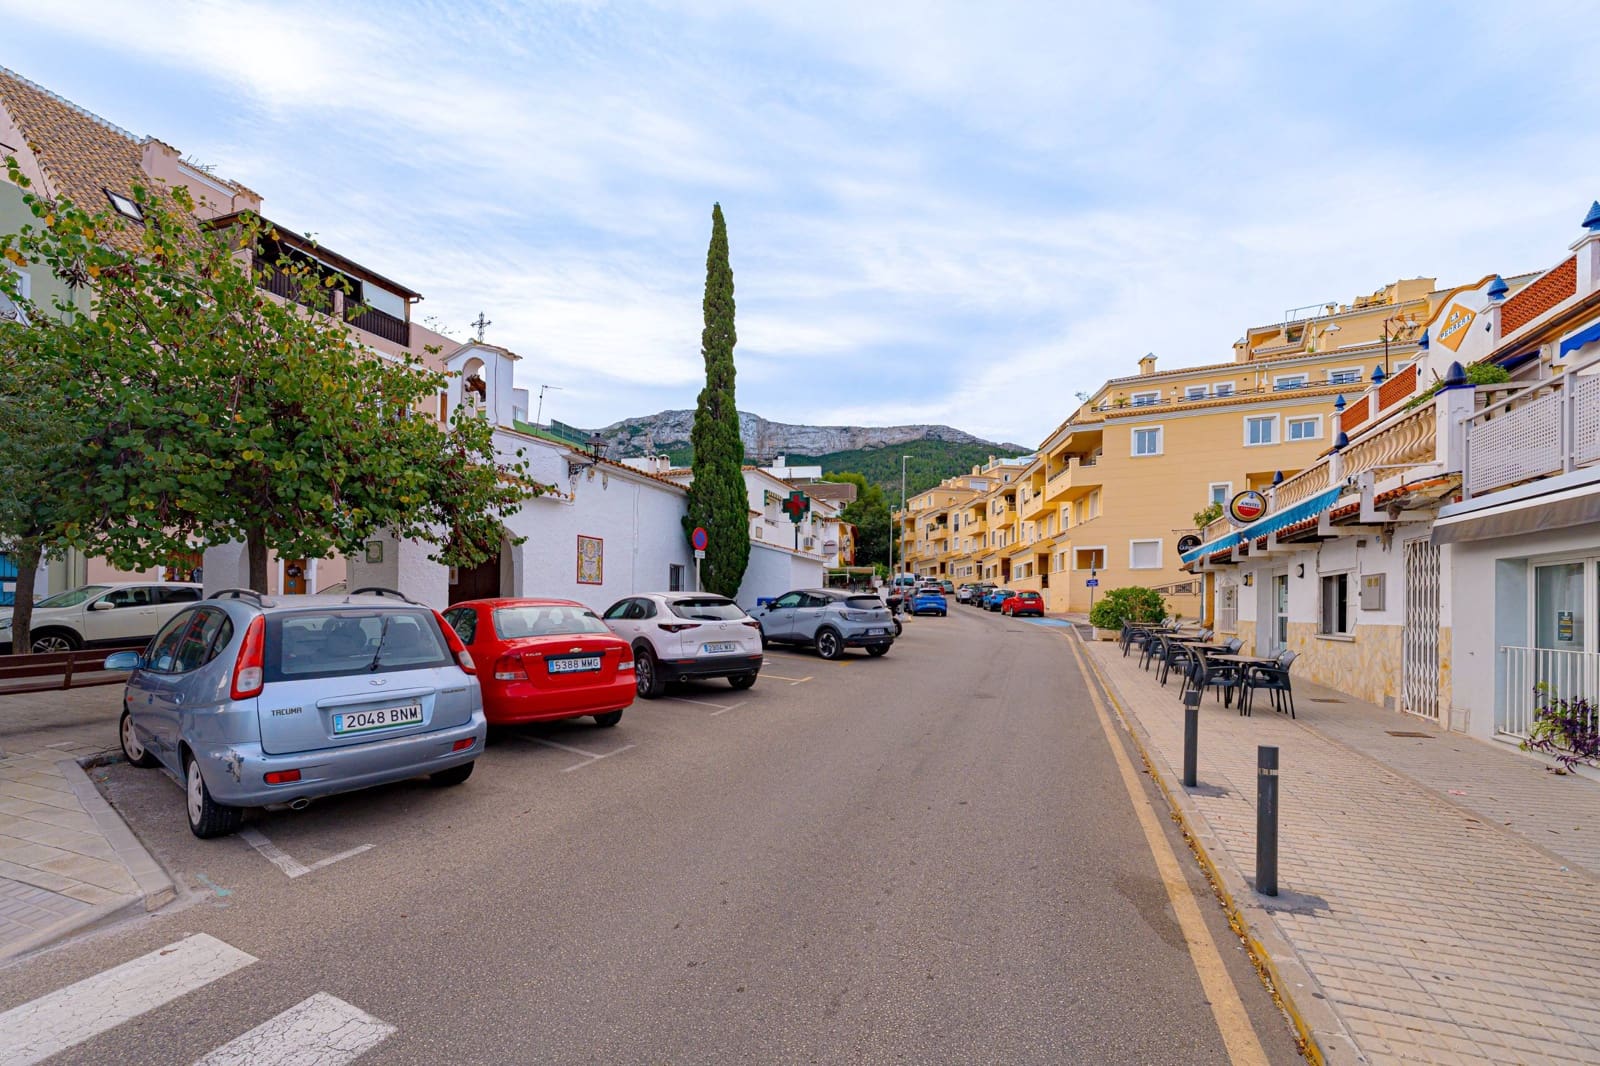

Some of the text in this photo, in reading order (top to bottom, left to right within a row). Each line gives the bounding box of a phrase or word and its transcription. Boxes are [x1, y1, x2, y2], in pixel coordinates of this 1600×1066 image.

[1450, 311, 1459, 322] LA
[1440, 314, 1471, 339] PEDRERA
[555, 658, 599, 670] 5388 MMG
[271, 707, 302, 717] TACUMA
[347, 707, 418, 728] 2048 BNM
